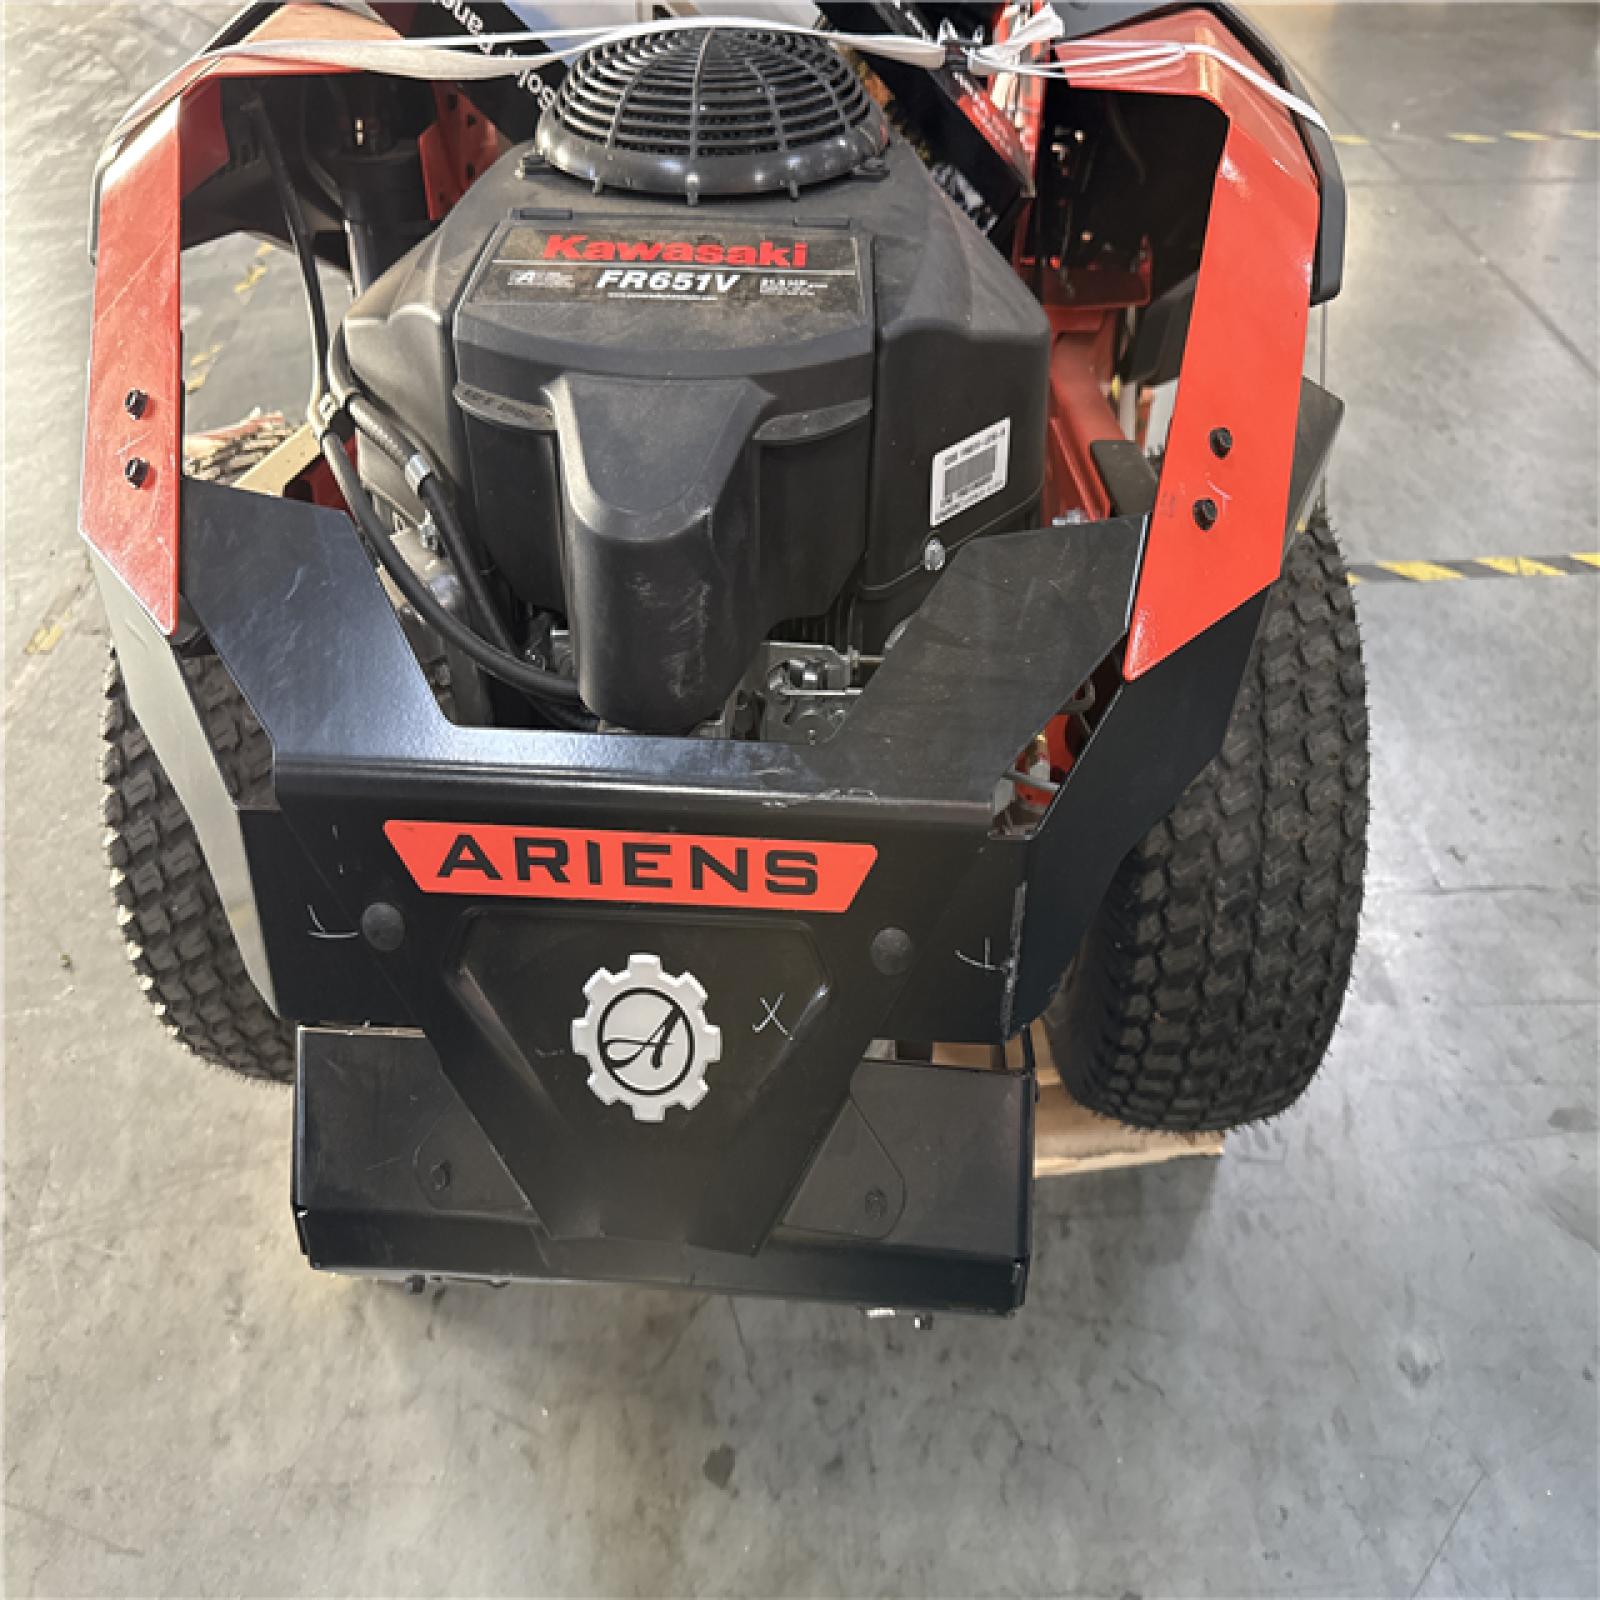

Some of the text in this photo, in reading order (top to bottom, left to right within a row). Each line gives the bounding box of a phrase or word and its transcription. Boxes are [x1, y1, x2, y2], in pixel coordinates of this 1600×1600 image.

[543, 234, 808, 268] Kawasaki
[595, 270, 741, 292] FR651V
[436, 834, 819, 895] ARIENS
